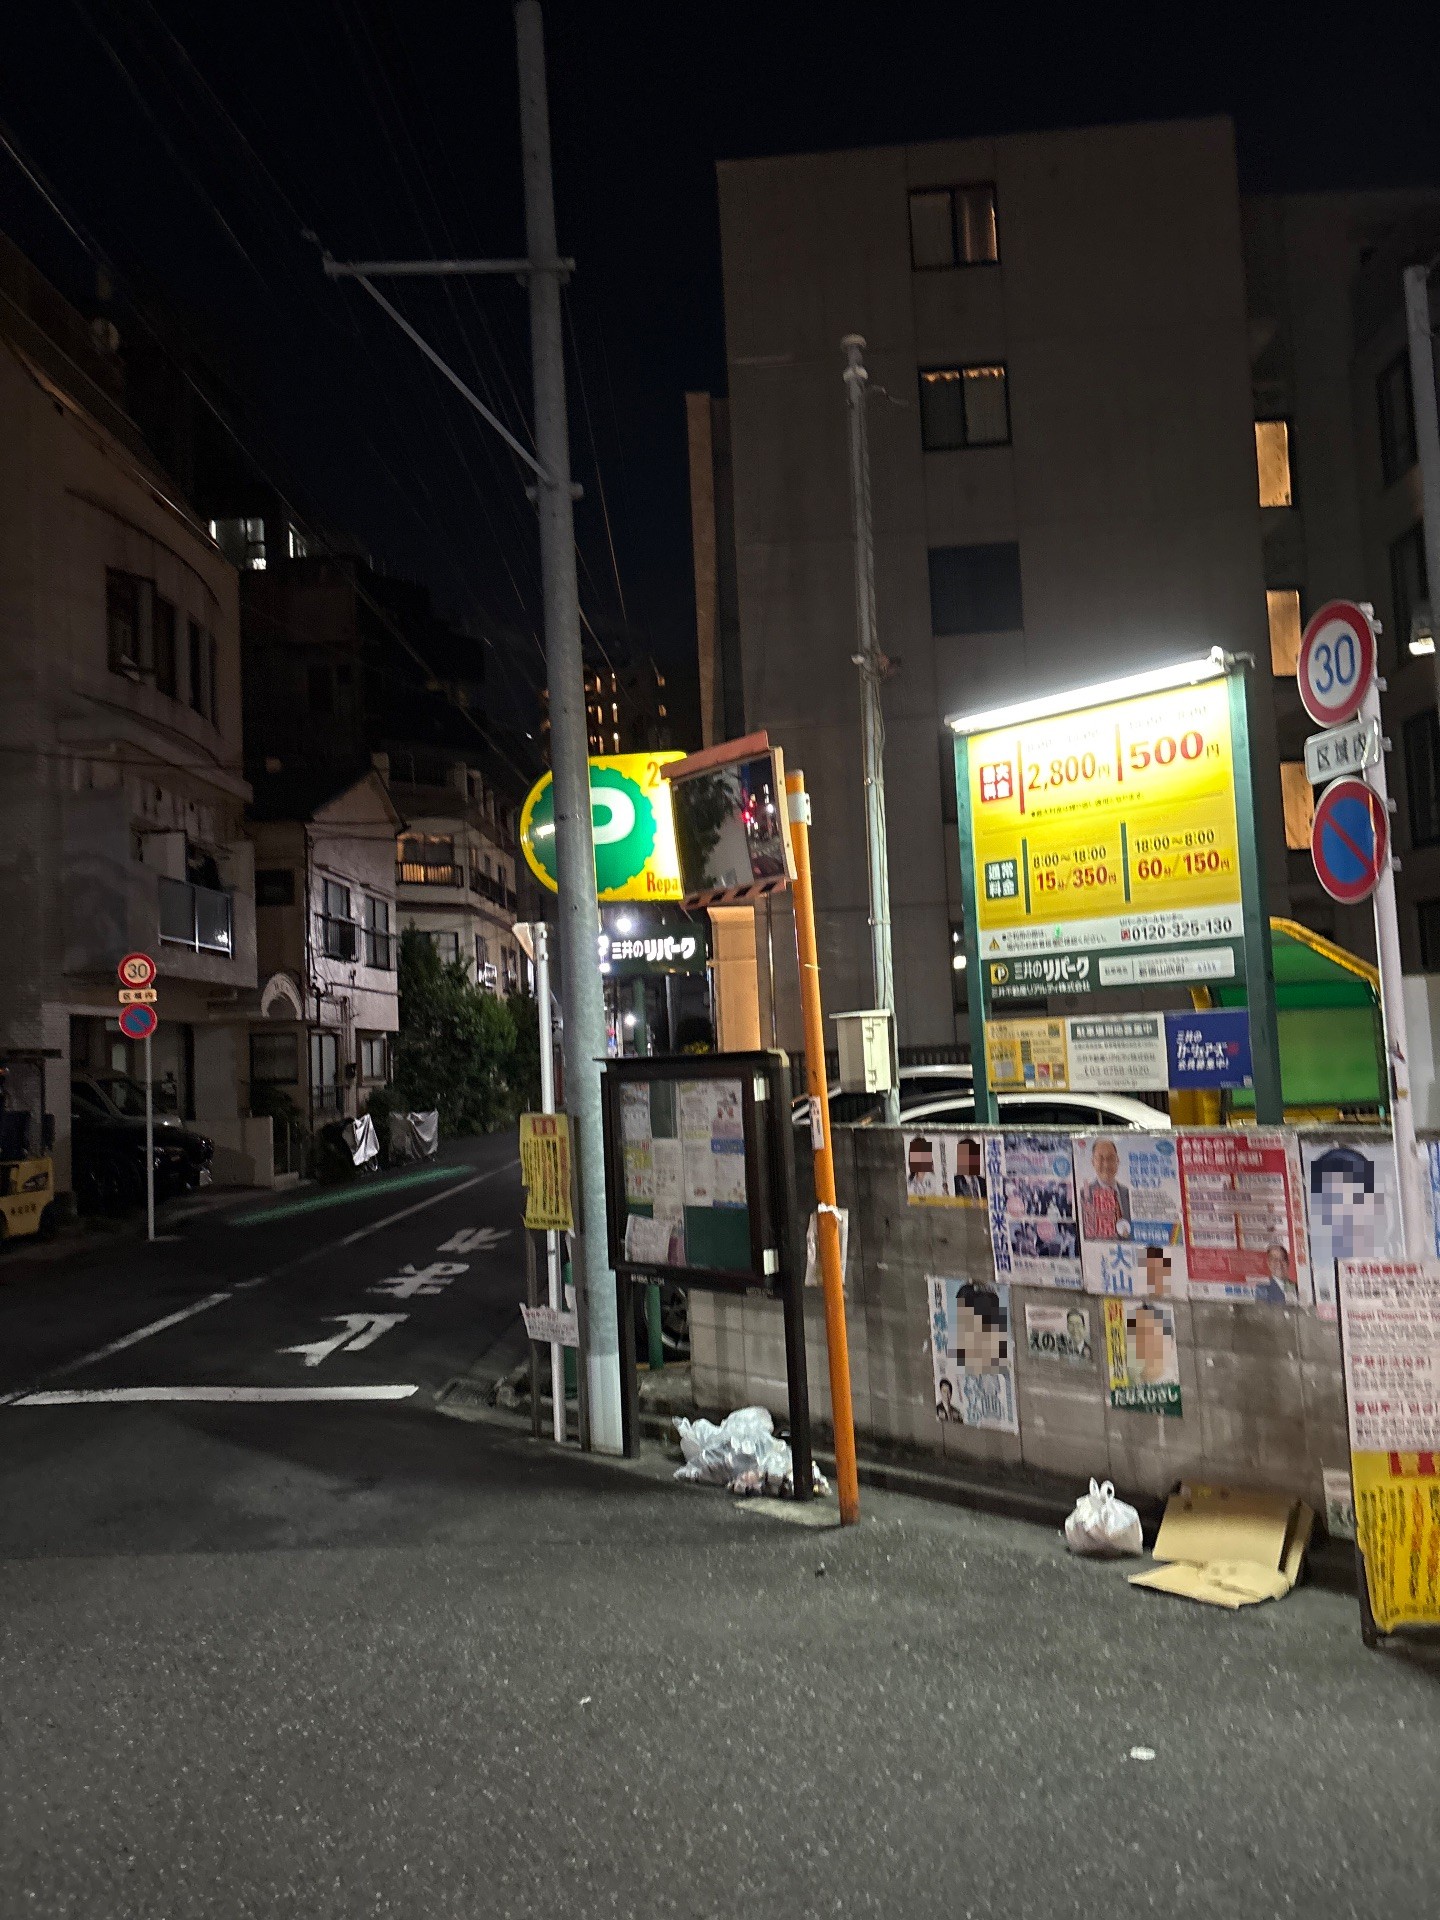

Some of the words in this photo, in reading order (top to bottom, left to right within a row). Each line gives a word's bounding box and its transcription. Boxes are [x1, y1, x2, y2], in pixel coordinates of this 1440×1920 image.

[1314, 634, 1356, 694] 30
[646, 871, 679, 893] Repa
[612, 936, 695, 961] 三井のリパーク
[127, 963, 148, 979] 30
[1014, 956, 1090, 982] 三井のリパーク
